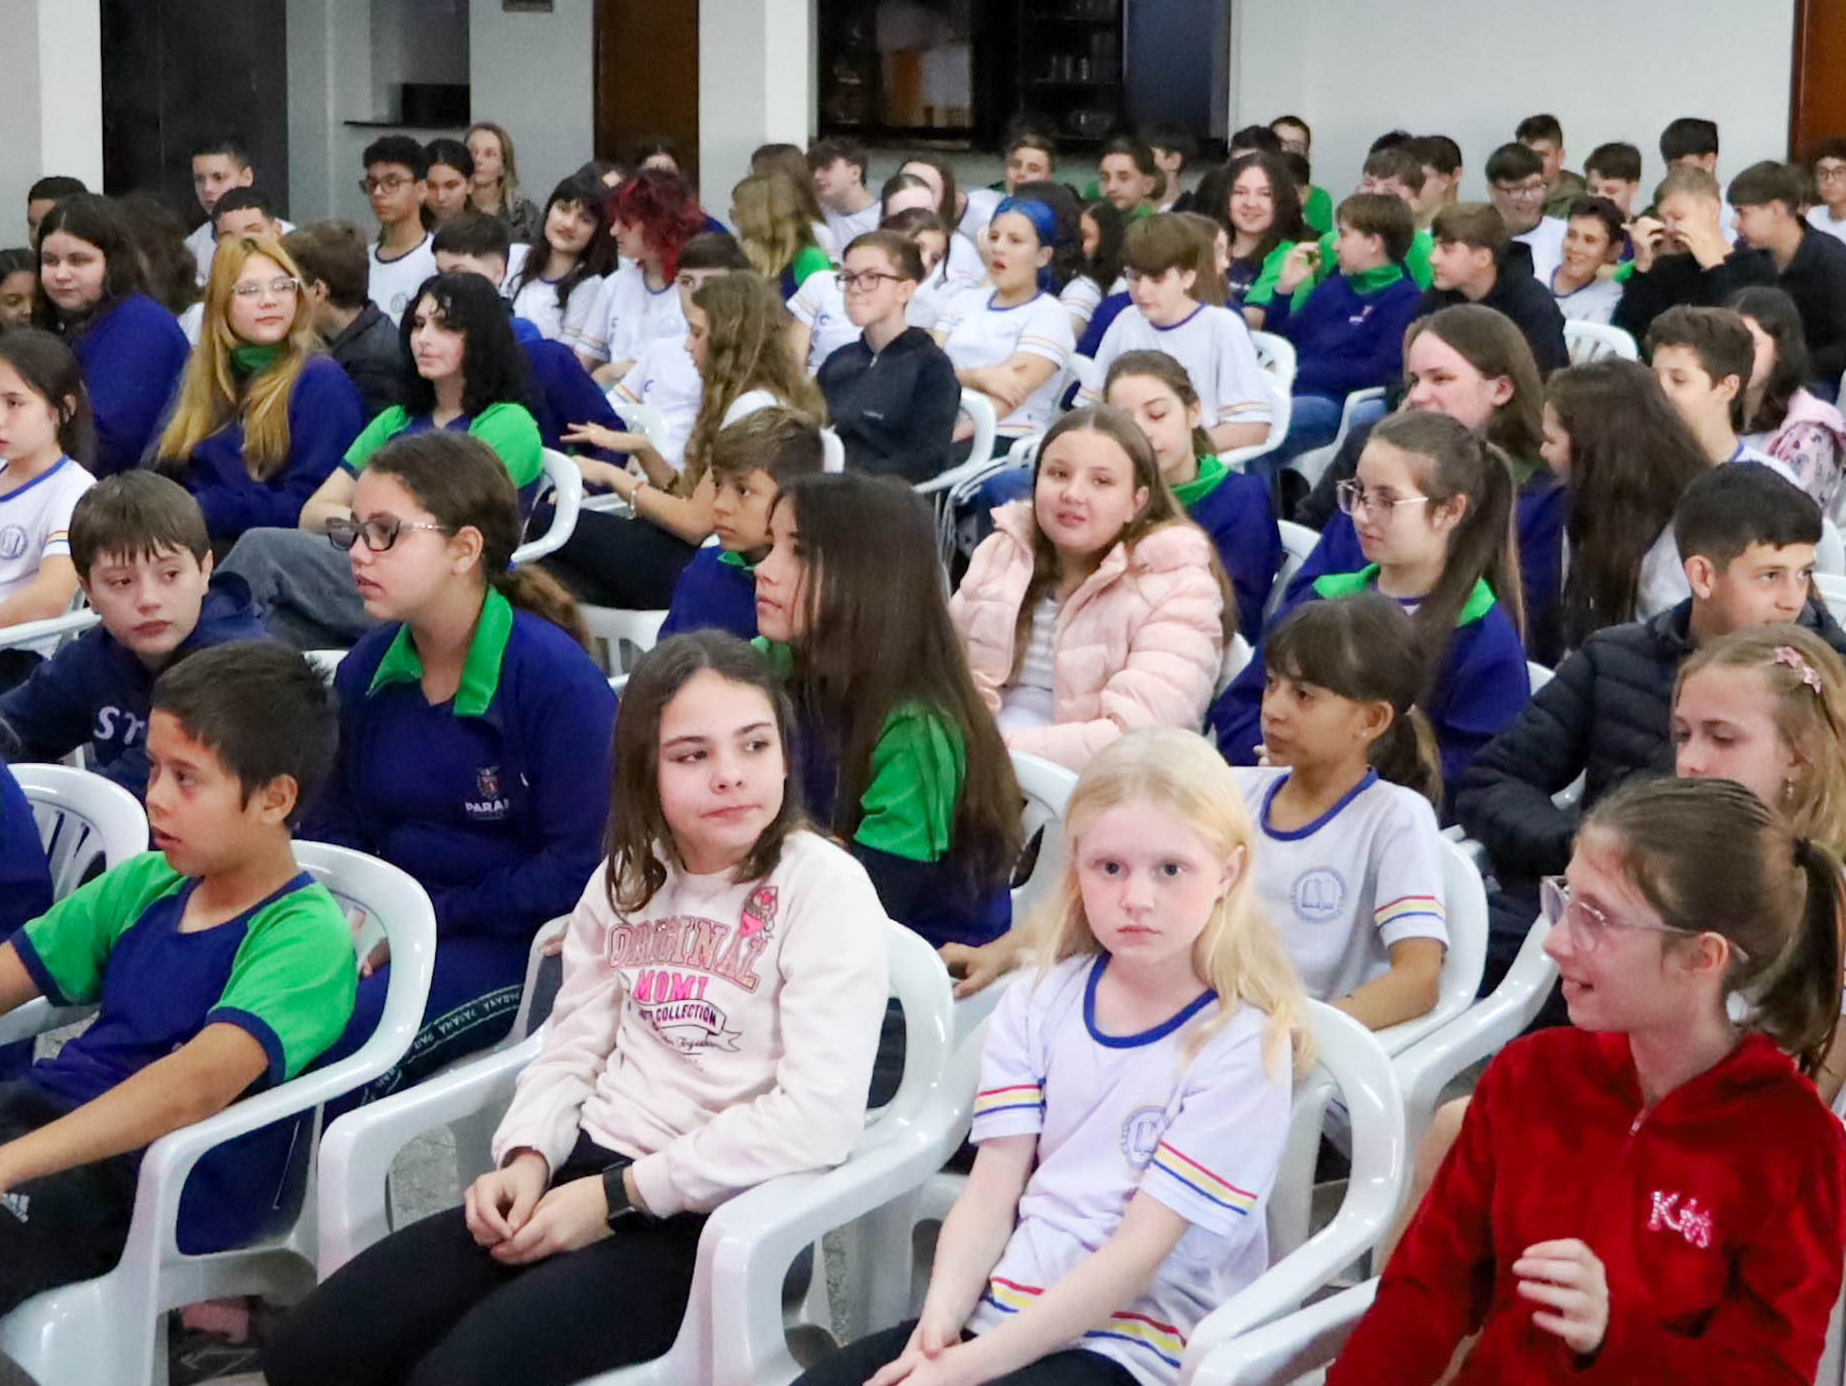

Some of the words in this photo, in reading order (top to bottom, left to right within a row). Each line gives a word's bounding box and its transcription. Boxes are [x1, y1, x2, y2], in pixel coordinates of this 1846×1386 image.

[607, 915, 767, 994] ORIGINAL
[632, 969, 710, 1003] MOMI
[656, 1003, 717, 1028] COLLECTION
